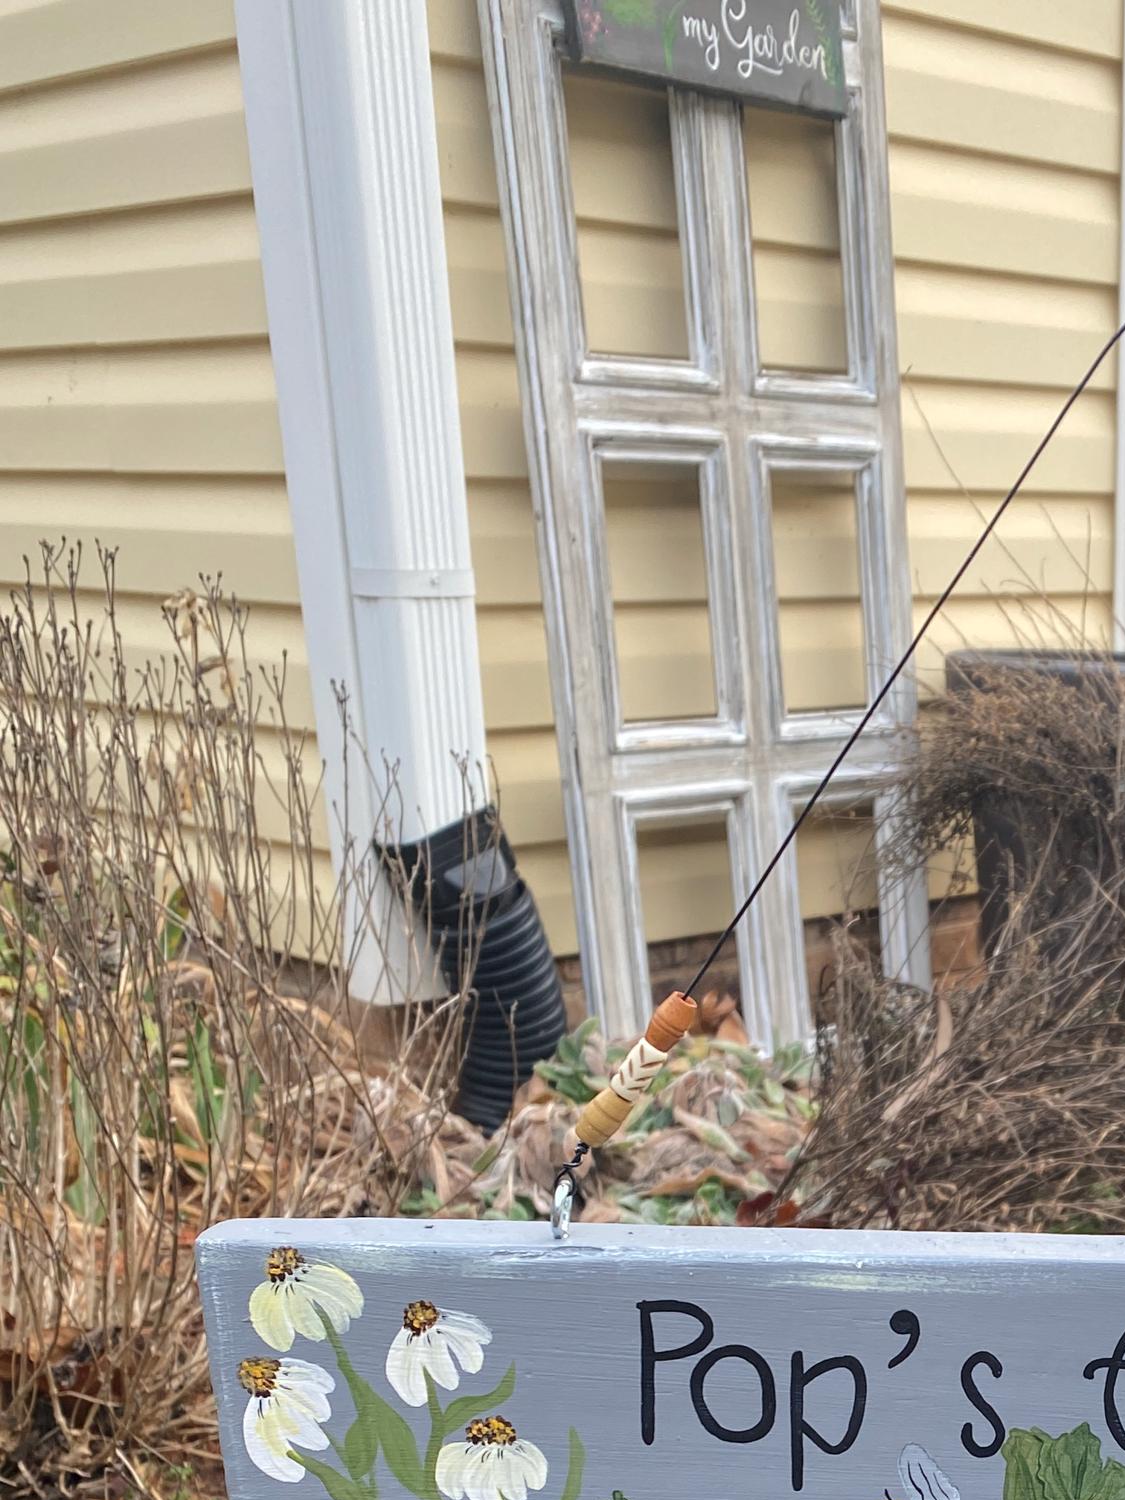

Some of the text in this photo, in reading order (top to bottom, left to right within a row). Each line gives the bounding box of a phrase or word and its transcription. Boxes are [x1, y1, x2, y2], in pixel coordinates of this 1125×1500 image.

[683, 0, 828, 79] my Garden
[636, 1300, 1006, 1491] Pop's
